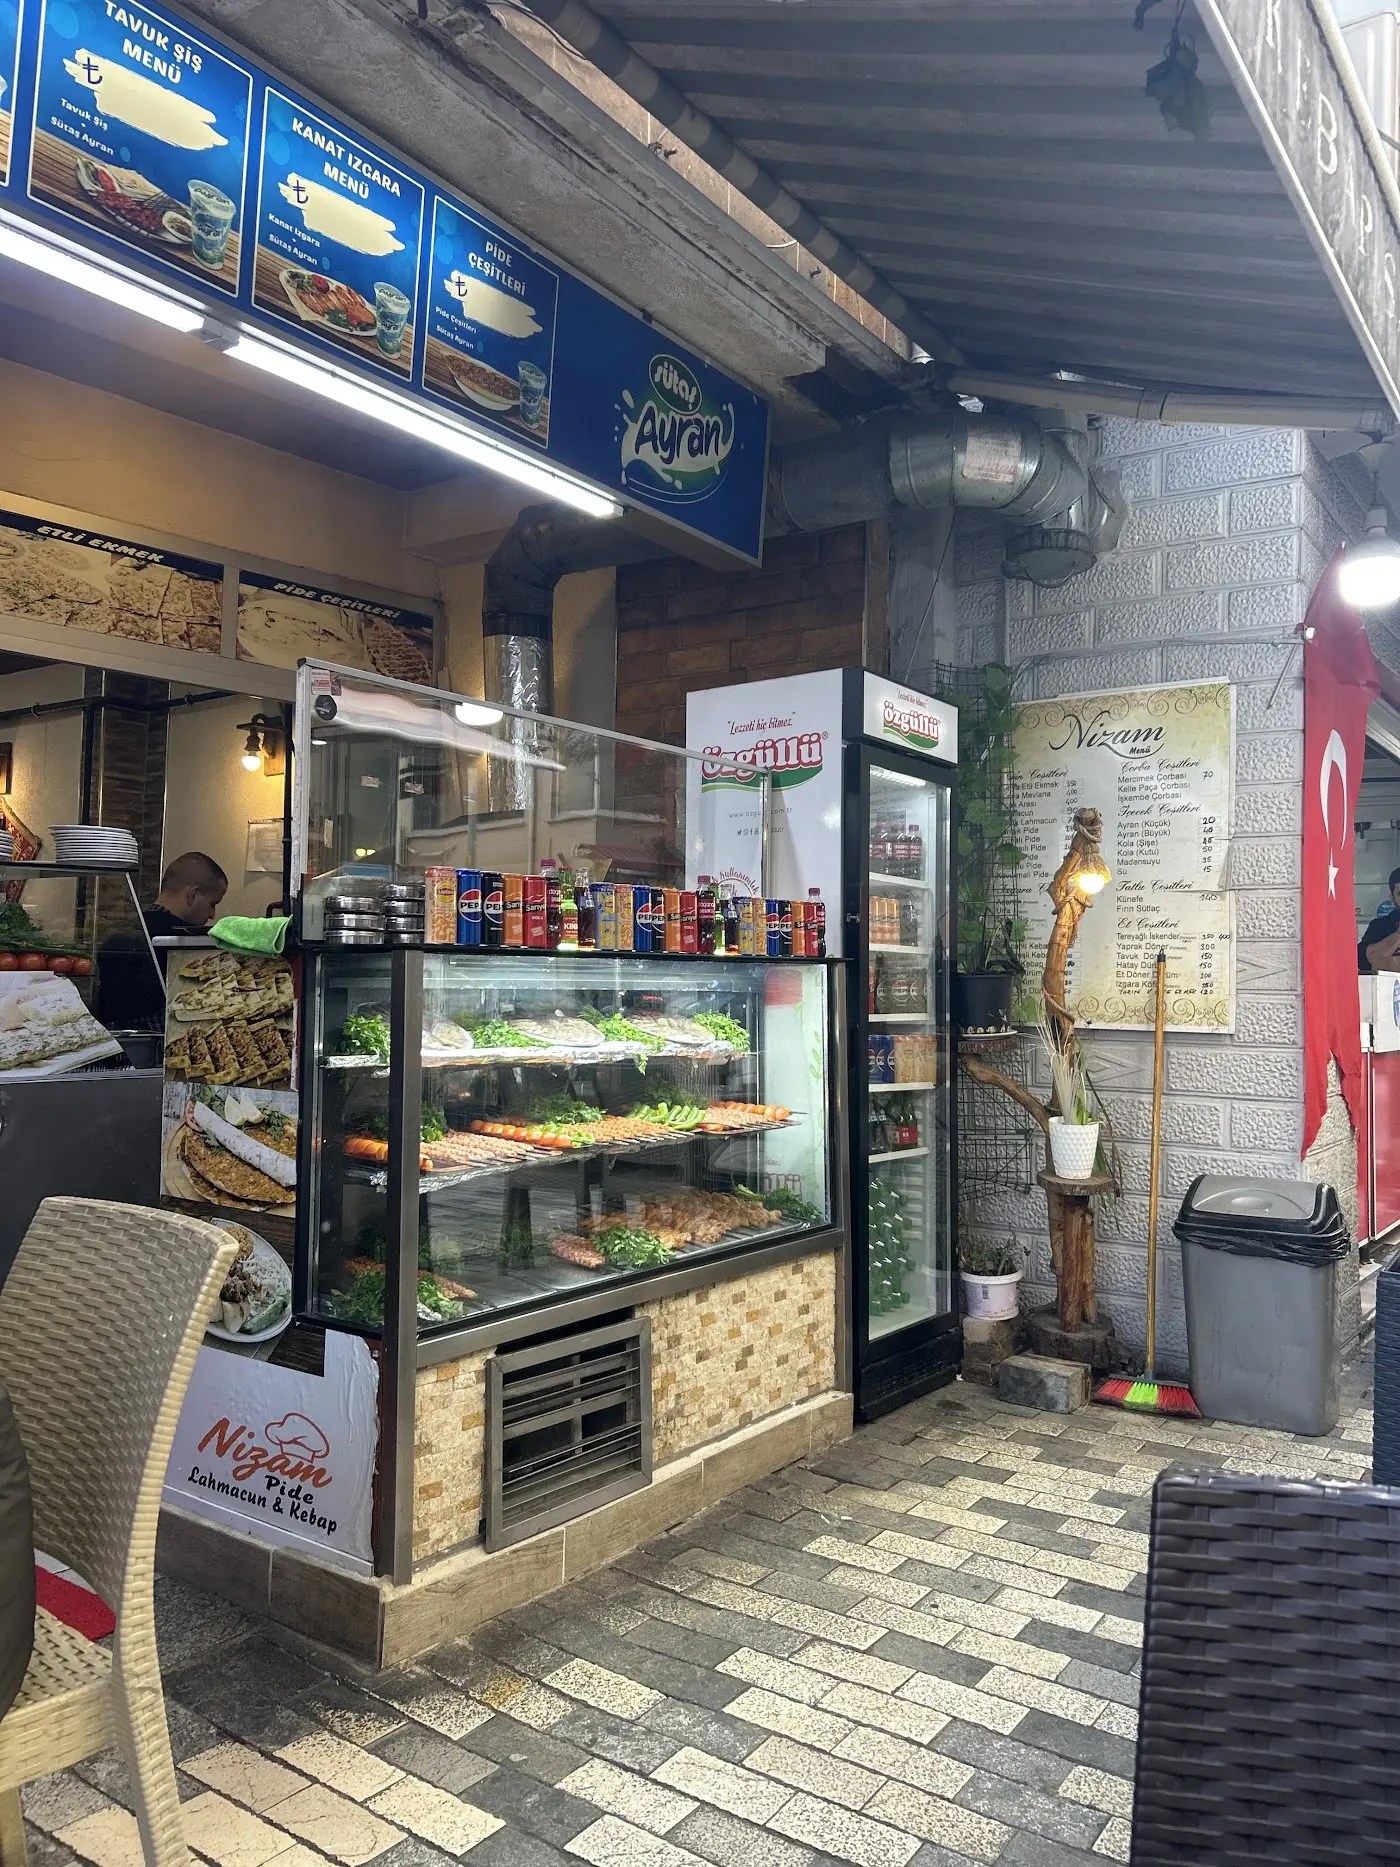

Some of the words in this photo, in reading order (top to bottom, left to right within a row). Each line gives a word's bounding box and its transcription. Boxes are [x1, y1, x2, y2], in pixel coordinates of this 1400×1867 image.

[104, 0, 169, 51] TAVUK
[173, 43, 203, 74] ŞİŞ
[122, 38, 181, 84] MENÜ
[61, 97, 91, 121] Tavuk
[93, 116, 108, 131] Şiş
[50, 116, 80, 139] Sütaş
[81, 133, 114, 156] Ayran
[291, 118, 345, 158] KANAT
[347, 153, 401, 197] IZGARA
[323, 161, 370, 200] MENÜ
[269, 213, 294, 232] Kanat
[294, 228, 320, 247] Izgara
[269, 234, 292, 252] Sütaş
[293, 247, 317, 265] Ayran
[485, 240, 513, 268] PİDE
[468, 252, 527, 296] ÇEŞİTLERİ
[435, 306, 449, 319] Pide
[451, 315, 477, 334] Çeşitleri
[436, 325, 454, 340] Sütaş
[454, 335, 474, 349] Ayran
[634, 405, 720, 465] Ayran
[37, 526, 86, 542] ETLİ
[88, 538, 164, 562] EKMEK
[273, 582, 317, 598] PİDE
[320, 594, 401, 619] ÇEŞİTLERİ
[756, 719, 767, 732] hiç
[1049, 710, 1167, 752] Nizam
[1129, 746, 1151, 755] Menü
[1121, 760, 1151, 775] Çorba
[1158, 757, 1201, 772] Çeşitleri
[1035, 781, 1059, 789] Ekmek
[1118, 774, 1155, 784] Mercimek
[1157, 772, 1187, 782] Çorbası
[1118, 784, 1137, 793] Kelle
[1139, 783, 1158, 792] Paça
[1160, 782, 1191, 791] Çorbası
[1022, 791, 1051, 799] Mevlana
[1152, 791, 1182, 801] Çorbası
[1158, 802, 1201, 817] Çeşitleri
[1020, 818, 1057, 826] Lahmacun
[1117, 822, 1139, 830] Ayran
[1141, 820, 1171, 830] (Küçük)
[1117, 831, 1139, 839] Ayran
[1141, 829, 1171, 839] (Büyük)
[1117, 839, 1134, 847] Kola
[1136, 838, 1158, 848] (Şişe)
[1136, 847, 1159, 857] (Kutu)
[1117, 858, 1161, 867] Madensuyu
[1151, 879, 1194, 893] Çeşitleri
[1116, 895, 1144, 903] Künefe
[1116, 904, 1134, 913] Fırın
[1136, 904, 1161, 913] Sütlaç
[1118, 917, 1132, 928] Et
[1137, 917, 1180, 931] Çeşitleri
[1116, 932, 1148, 941] Tereyağlı
[1149, 931, 1180, 940] İskender
[1116, 943, 1143, 951] Yaprak
[1145, 942, 1169, 950] Döner
[1116, 952, 1139, 960] Tavuk
[1116, 962, 1139, 970] Hatay
[198, 1417, 333, 1489] Nizam
[265, 1474, 314, 1505] Pide
[187, 1466, 267, 1508] Lahmacun
[272, 1498, 284, 1515] &
[289, 1500, 338, 1536] Kebap
